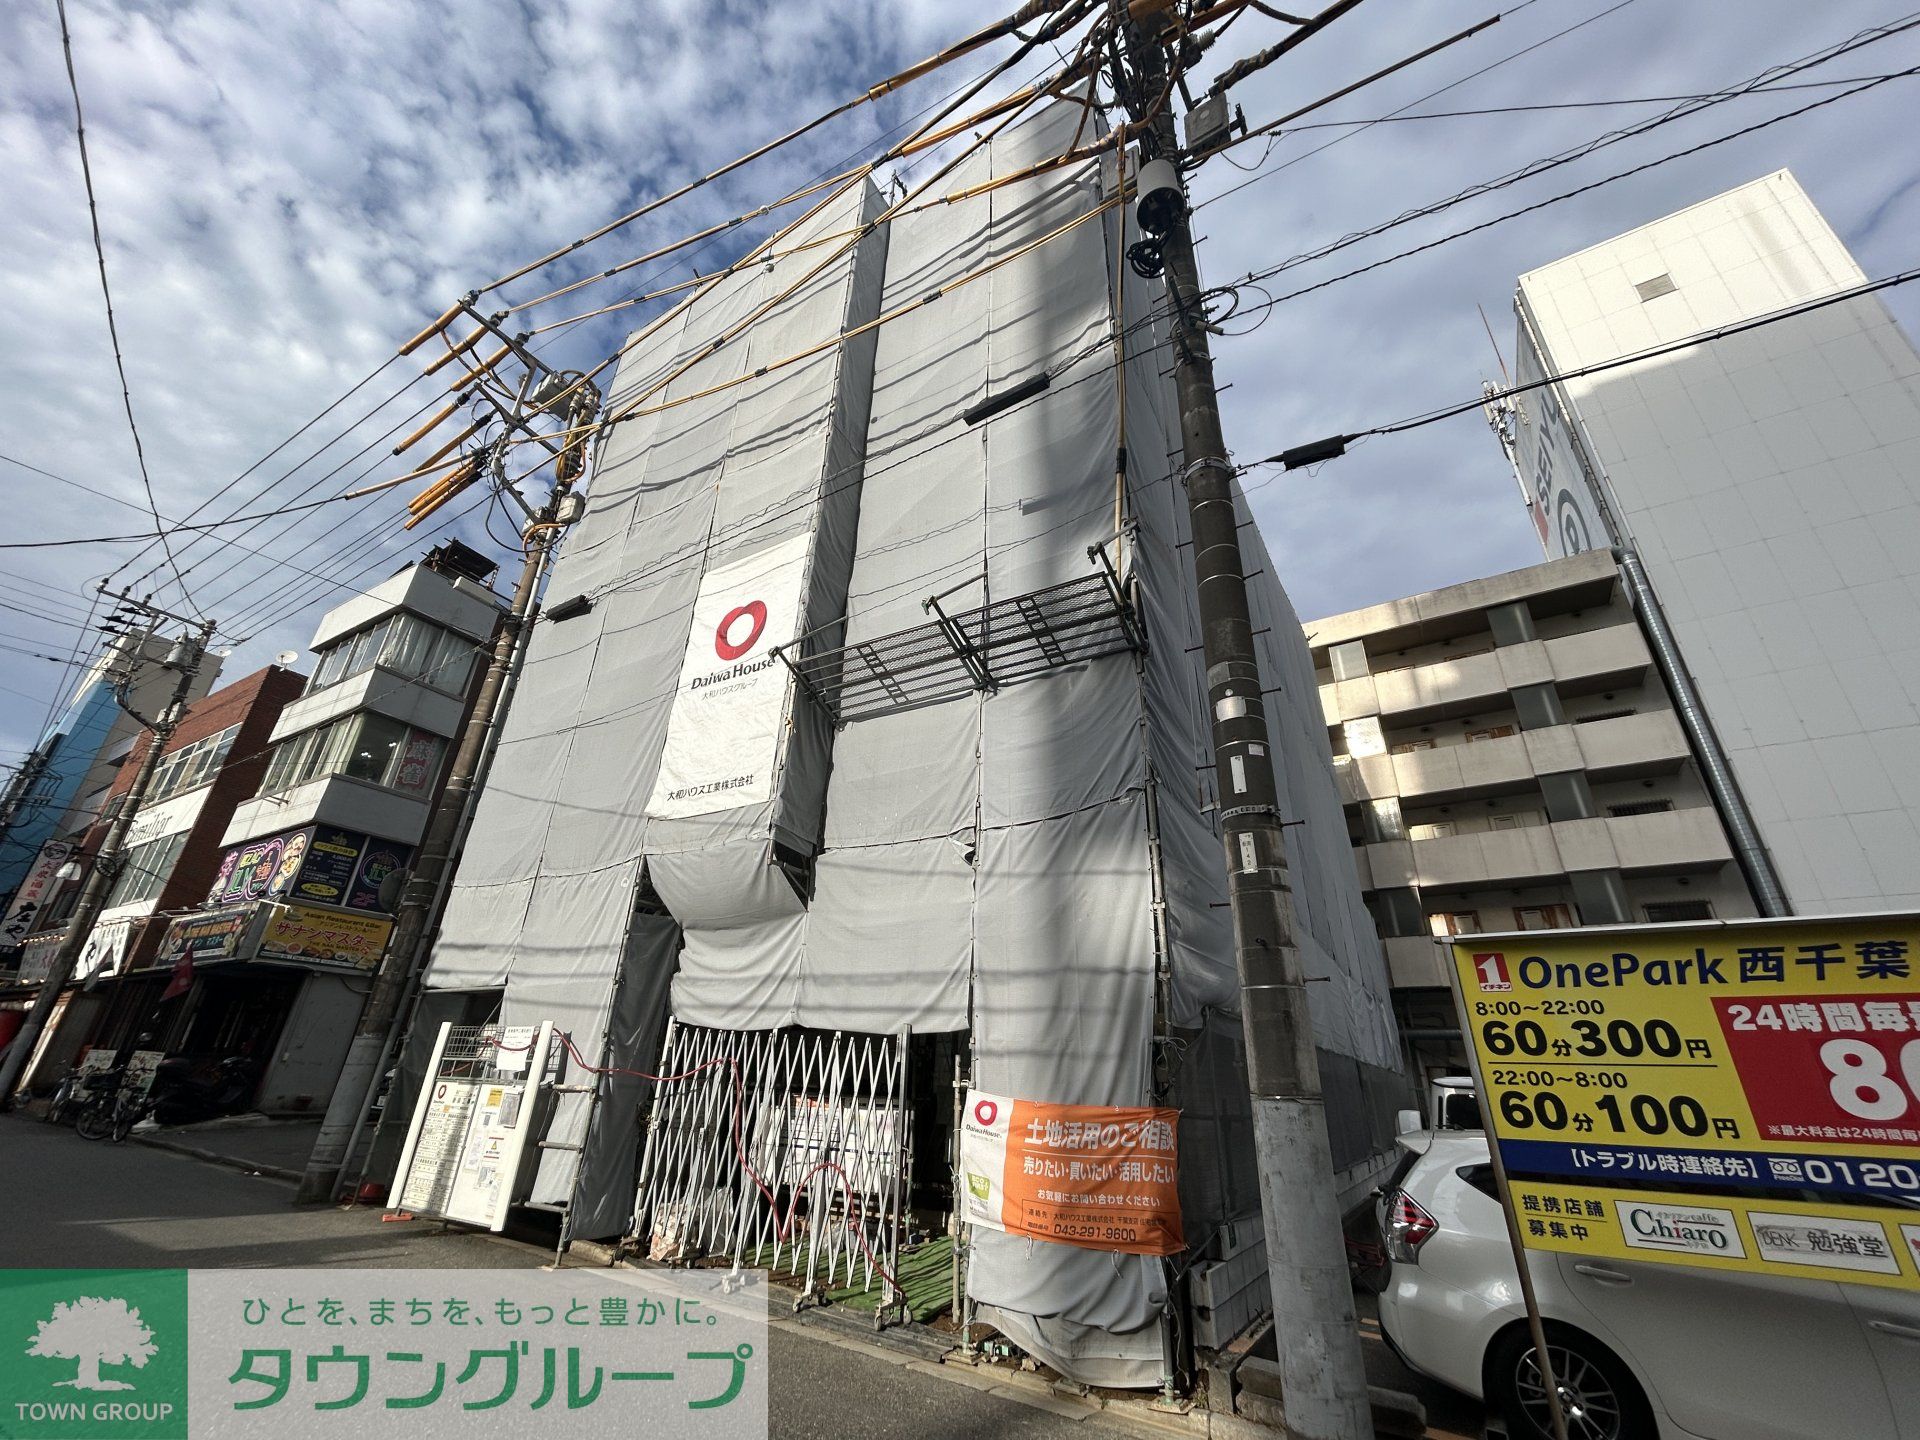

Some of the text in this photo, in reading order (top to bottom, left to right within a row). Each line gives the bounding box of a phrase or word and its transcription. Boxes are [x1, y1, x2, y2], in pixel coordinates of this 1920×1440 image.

[691, 659, 776, 690] Daiwa House
[702, 677, 759, 700] 大和ハウスグループ
[667, 774, 754, 801] 大和ハウス工業株式会社
[1518, 940, 1911, 989] OnePark 西千葉
[1482, 1018, 1712, 1059] 60分300円
[966, 1124, 983, 1134] Daiwa
[1500, 1090, 1740, 1140] 60分100円
[1023, 1118, 1175, 1151] 土地活用のご相談
[1767, 1124, 1920, 1141] ※最大料金は24時間毎
[1570, 1148, 1759, 1179] 【トラブル時連絡先】
[1037, 1189, 1161, 1207] お気軽にお問い合わせください
[1521, 1193, 1605, 1218] 提携店舗
[1053, 1224, 1137, 1242] 043-291-9600
[1527, 1218, 1589, 1241] 募集中
[1630, 1208, 1727, 1249] Chiaro
[1807, 1230, 1889, 1259] 勉強堂
